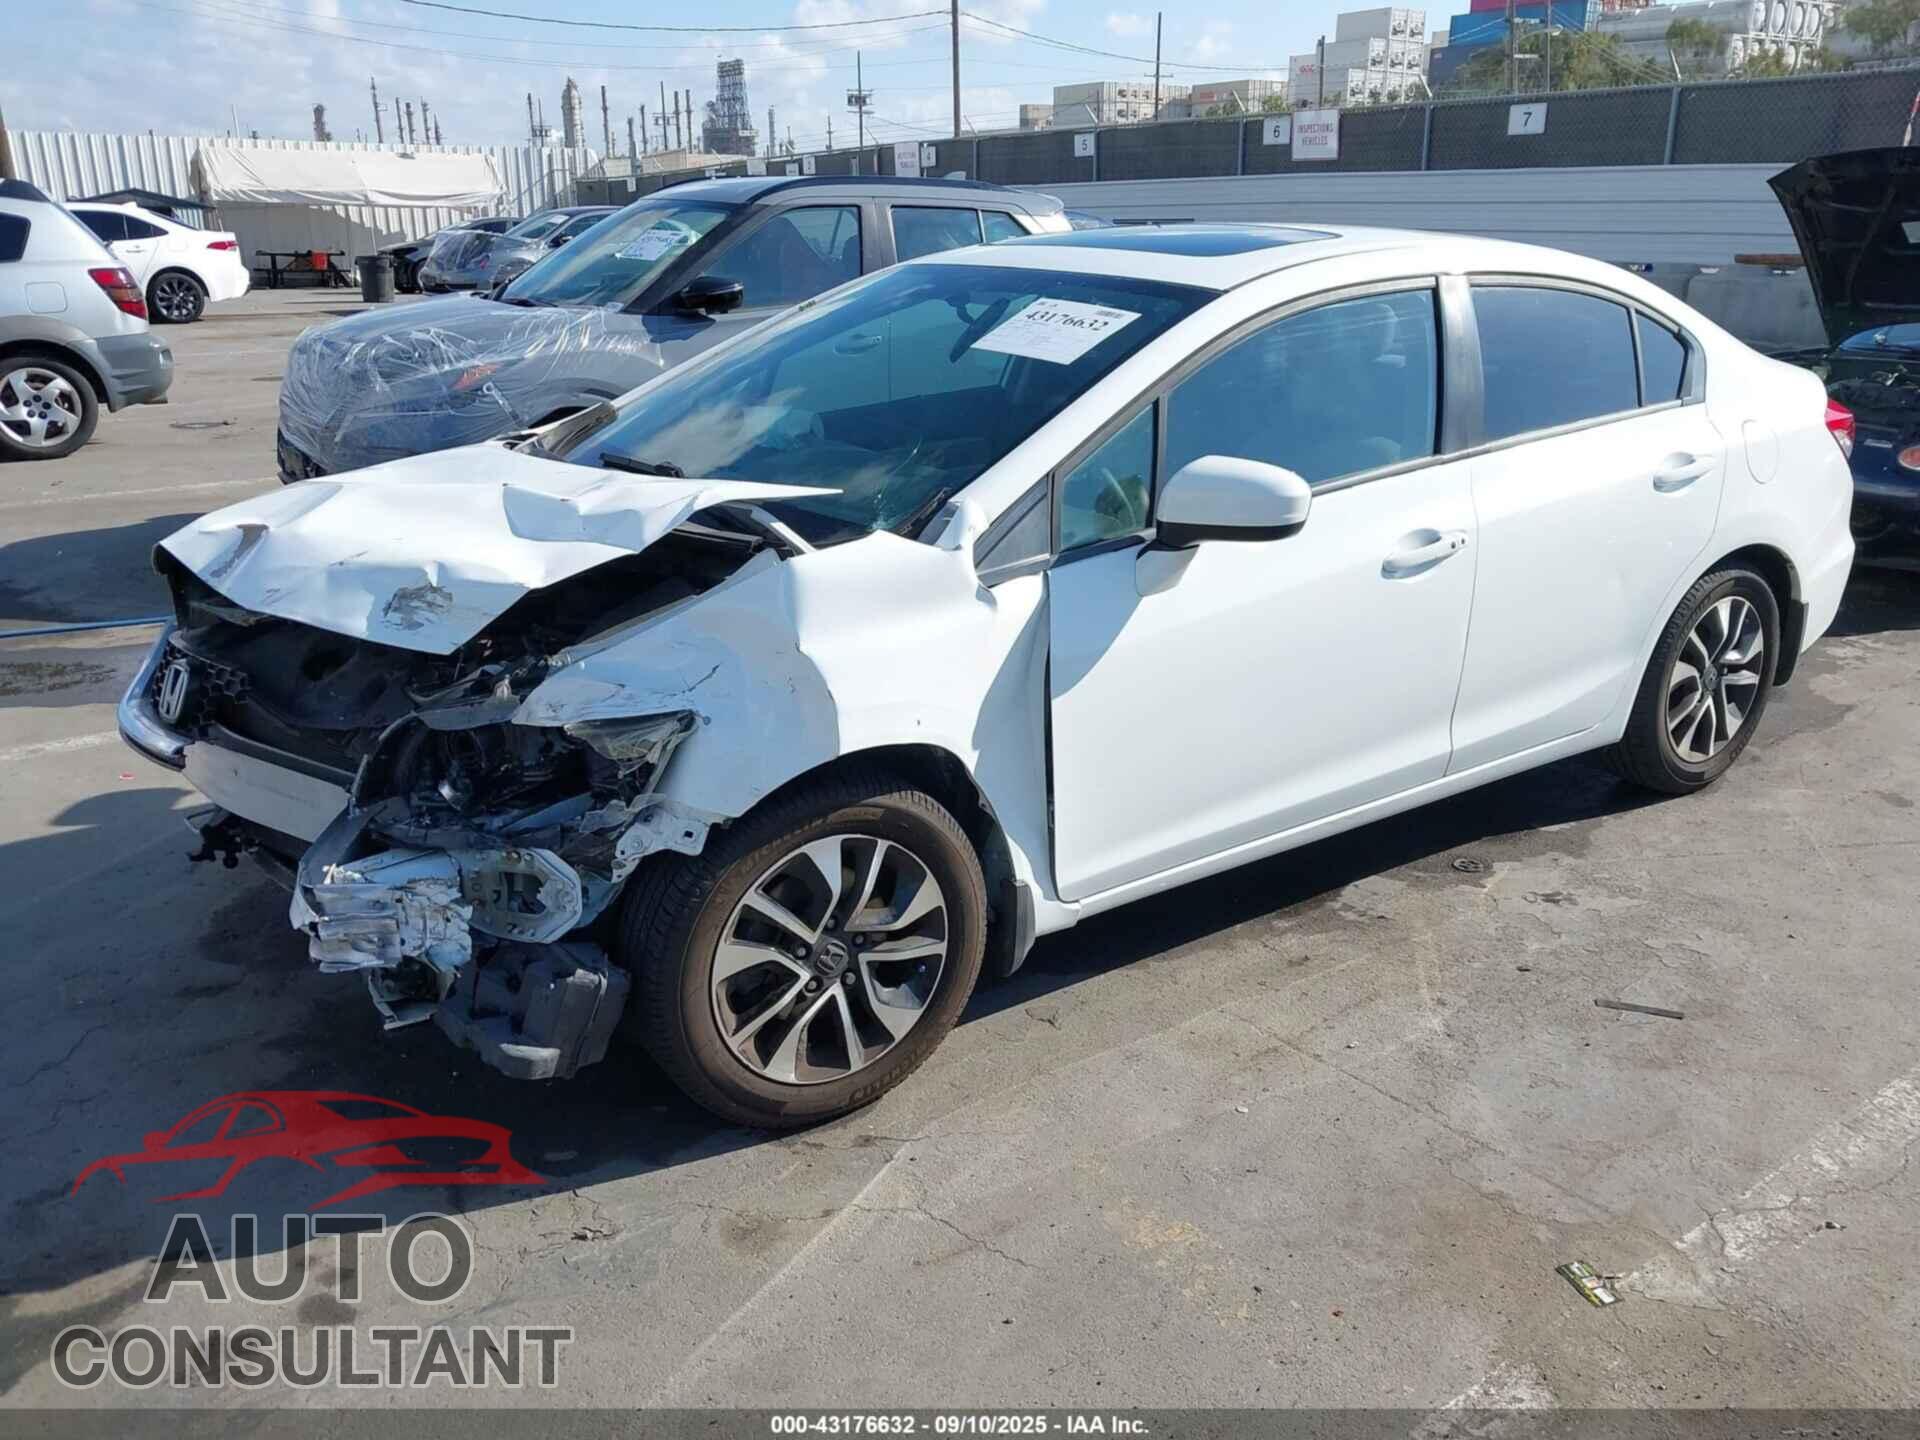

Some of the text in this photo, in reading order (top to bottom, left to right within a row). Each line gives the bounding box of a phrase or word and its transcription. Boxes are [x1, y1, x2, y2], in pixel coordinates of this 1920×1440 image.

[1523, 111, 1533, 127] 7
[1273, 125, 1281, 138] 6
[1081, 138, 1088, 151] 5
[1025, 310, 1109, 332] 43176632
